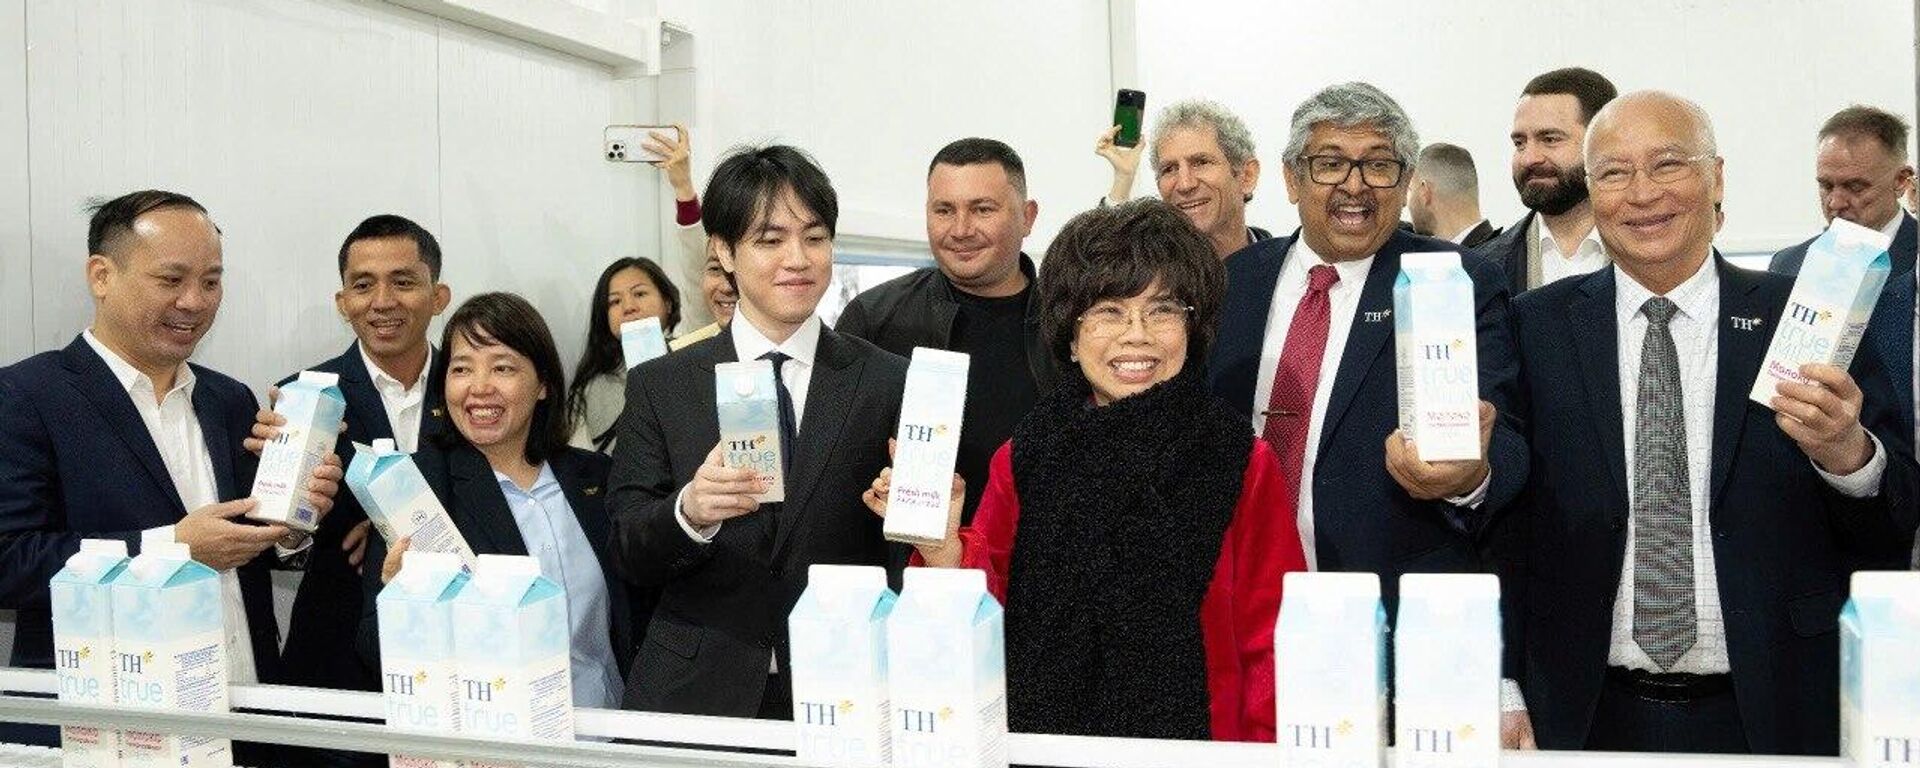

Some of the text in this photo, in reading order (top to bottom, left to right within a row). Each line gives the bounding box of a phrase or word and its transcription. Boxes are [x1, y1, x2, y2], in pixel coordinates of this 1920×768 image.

[1364, 312, 1382, 322] TH
[1731, 316, 1753, 331] TH
[1790, 301, 1819, 327] TH
[1420, 344, 1450, 360] TH
[905, 424, 934, 442] TH
[728, 440, 755, 451] TH
[729, 450, 776, 465] true
[897, 486, 919, 497] Fresh
[57, 649, 80, 669] TH
[119, 652, 143, 674] TH
[58, 670, 99, 699] true
[120, 674, 163, 703] true
[386, 673, 415, 695] TH
[462, 680, 491, 702] TH
[799, 701, 836, 726] TH
[897, 708, 935, 733] TH
[1287, 724, 1331, 749] TH
[1407, 728, 1453, 753] TH
